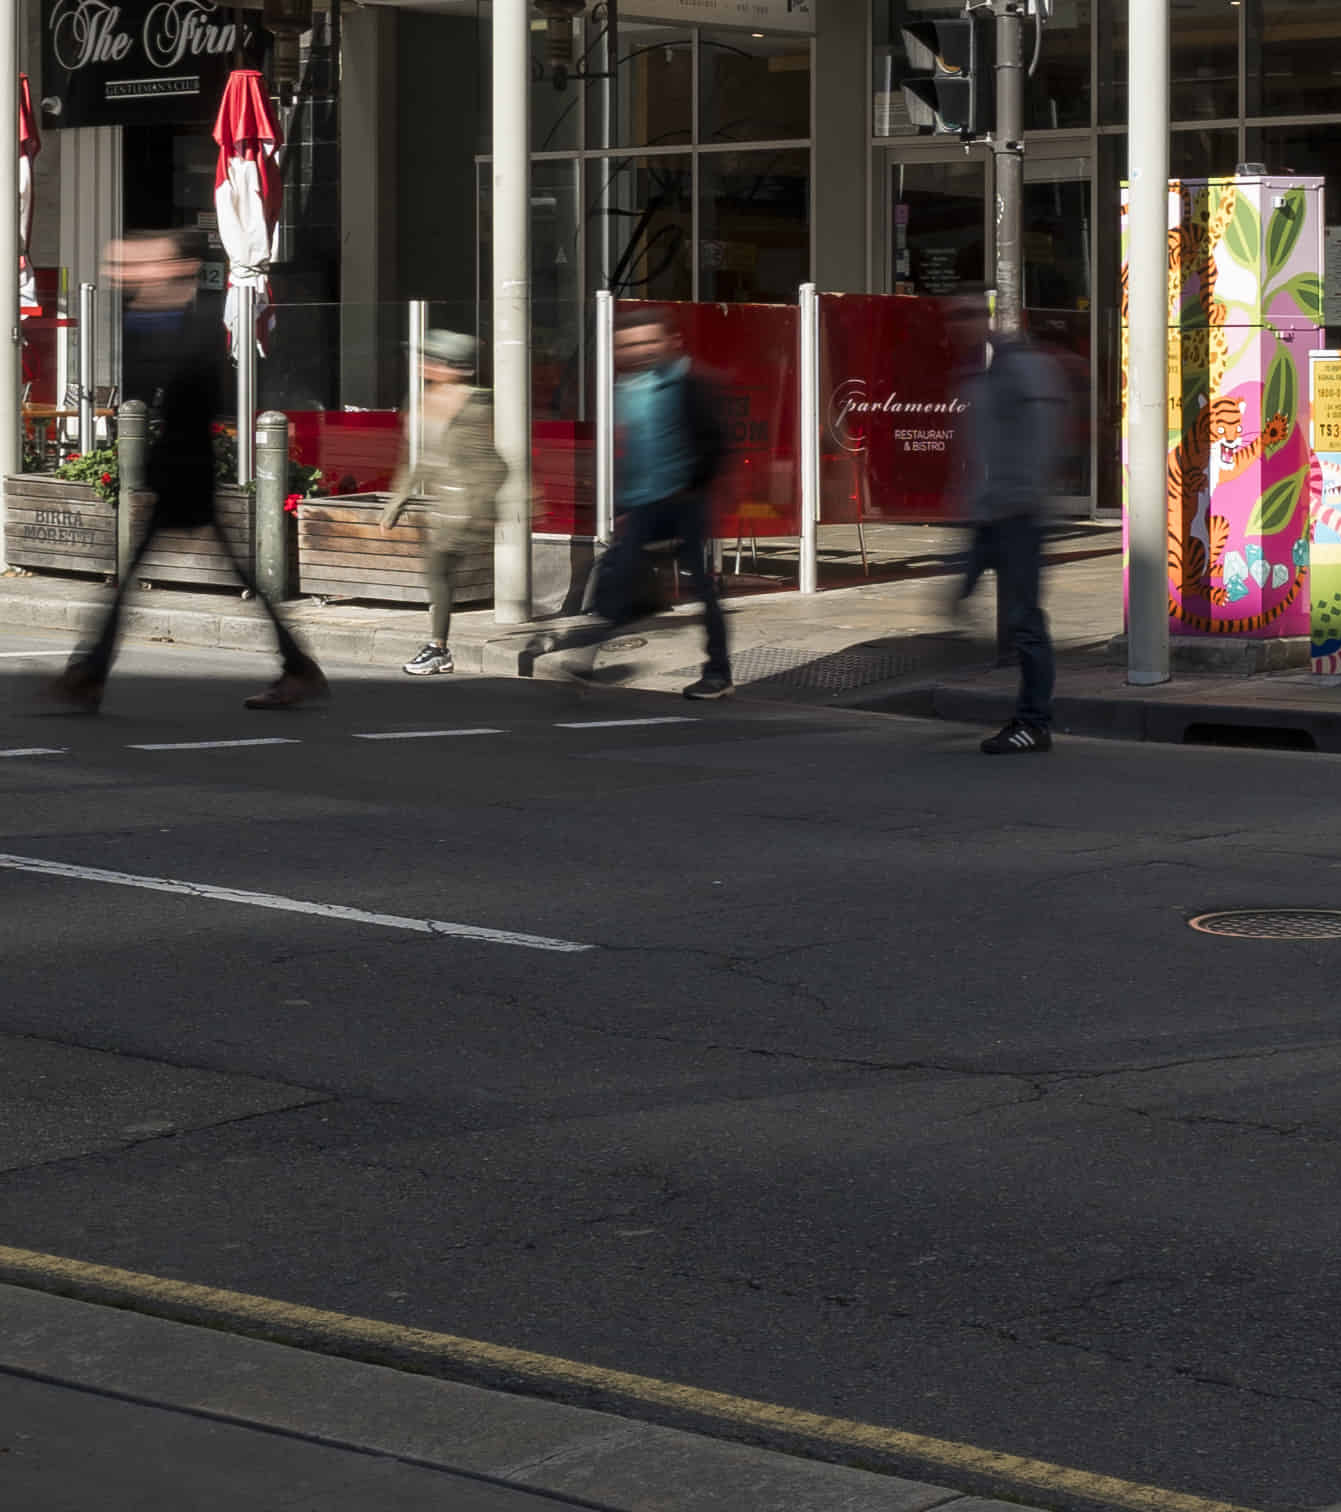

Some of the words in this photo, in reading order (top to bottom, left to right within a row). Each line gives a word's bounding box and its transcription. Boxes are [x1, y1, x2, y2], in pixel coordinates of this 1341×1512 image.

[835, 392, 970, 427] parlamento
[894, 429, 955, 440] RESTAURANT
[912, 441, 945, 451] BISTRO
